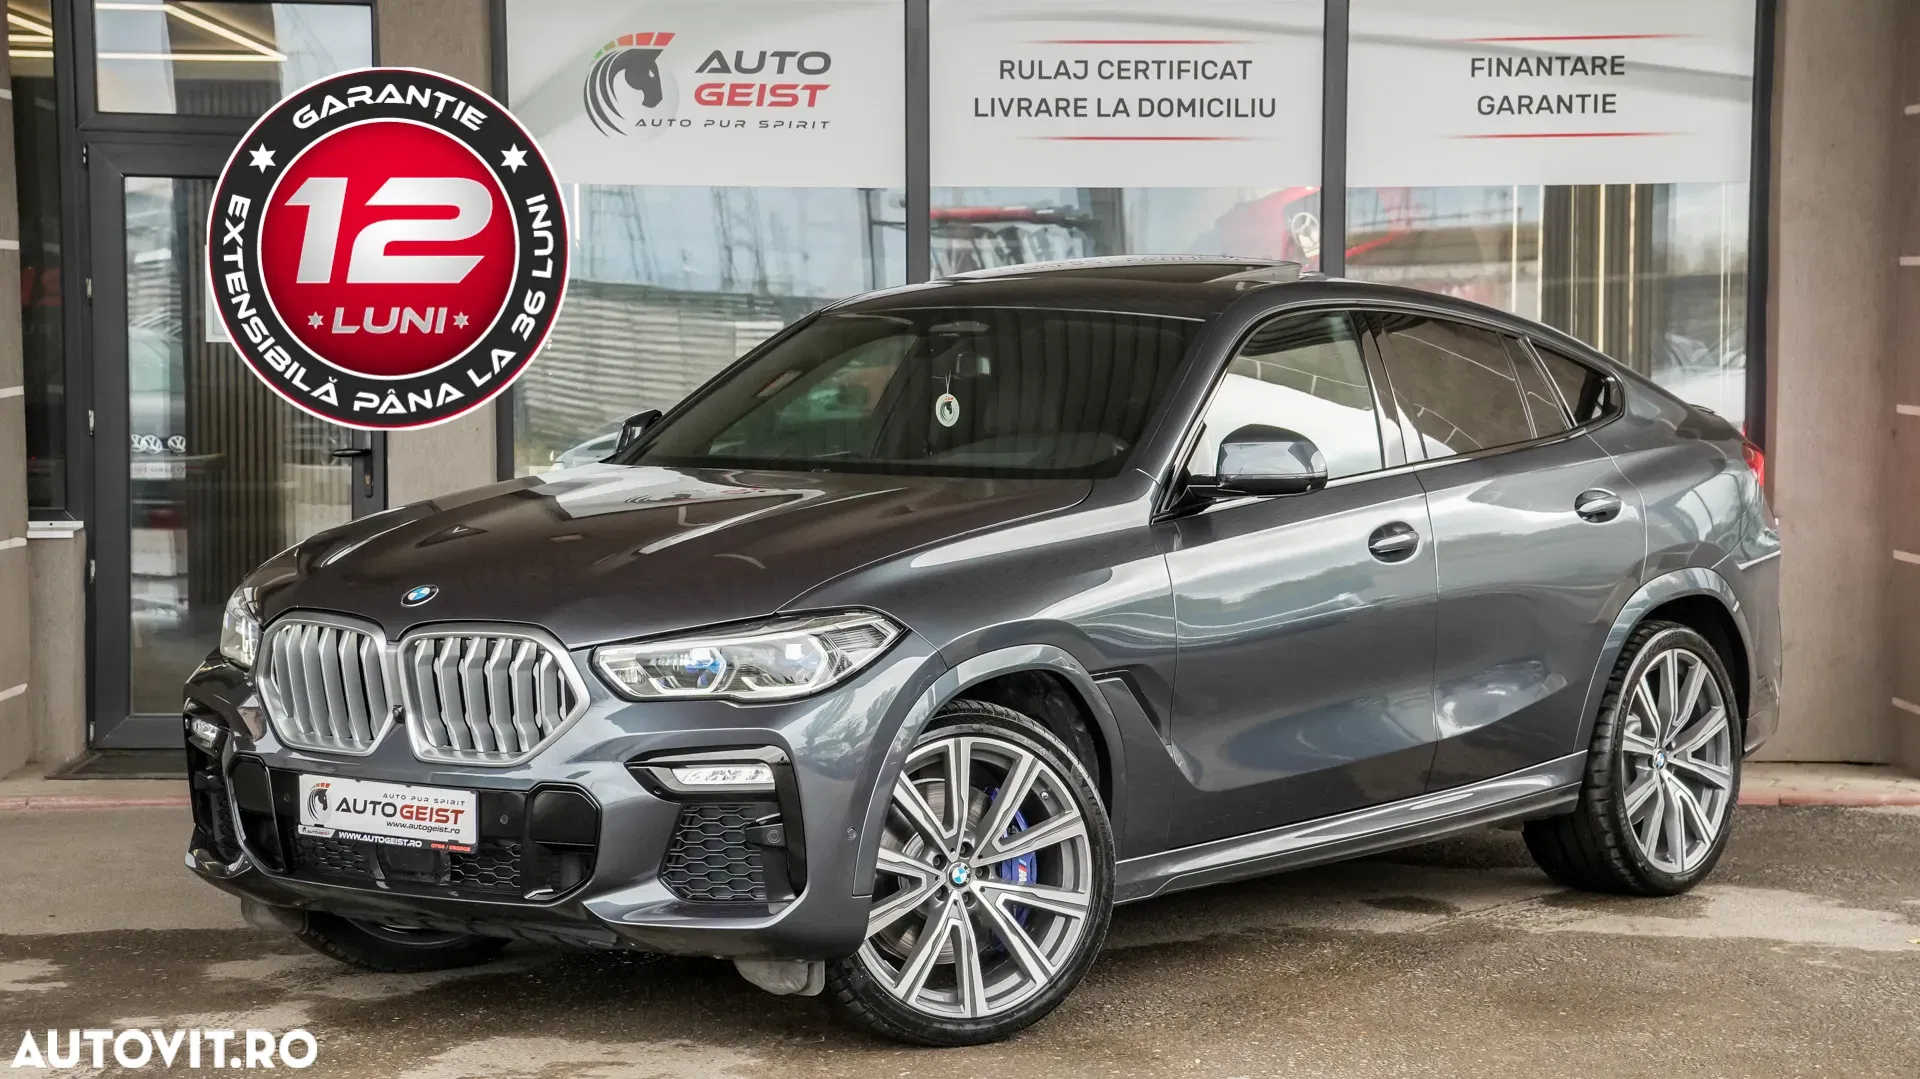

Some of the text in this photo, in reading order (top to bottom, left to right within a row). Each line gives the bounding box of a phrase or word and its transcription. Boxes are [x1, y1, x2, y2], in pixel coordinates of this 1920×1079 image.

[695, 50, 832, 75] AUTO
[999, 59, 1253, 80] RULAJ CERTIFICAT
[1471, 55, 1625, 78] FINANTARE
[694, 82, 832, 108] GEIST
[1477, 93, 1617, 116] GARANTIE
[974, 97, 1276, 118] LIVRARE LA DOMICILIU
[634, 118, 831, 130] AUTO PUR SPIRIT
[410, 795, 430, 803] PUR
[433, 798, 466, 806] SPIRIT
[386, 821, 461, 834] www.autogeist.ro
[338, 831, 423, 848] WWW.AUTOGEIST.RO
